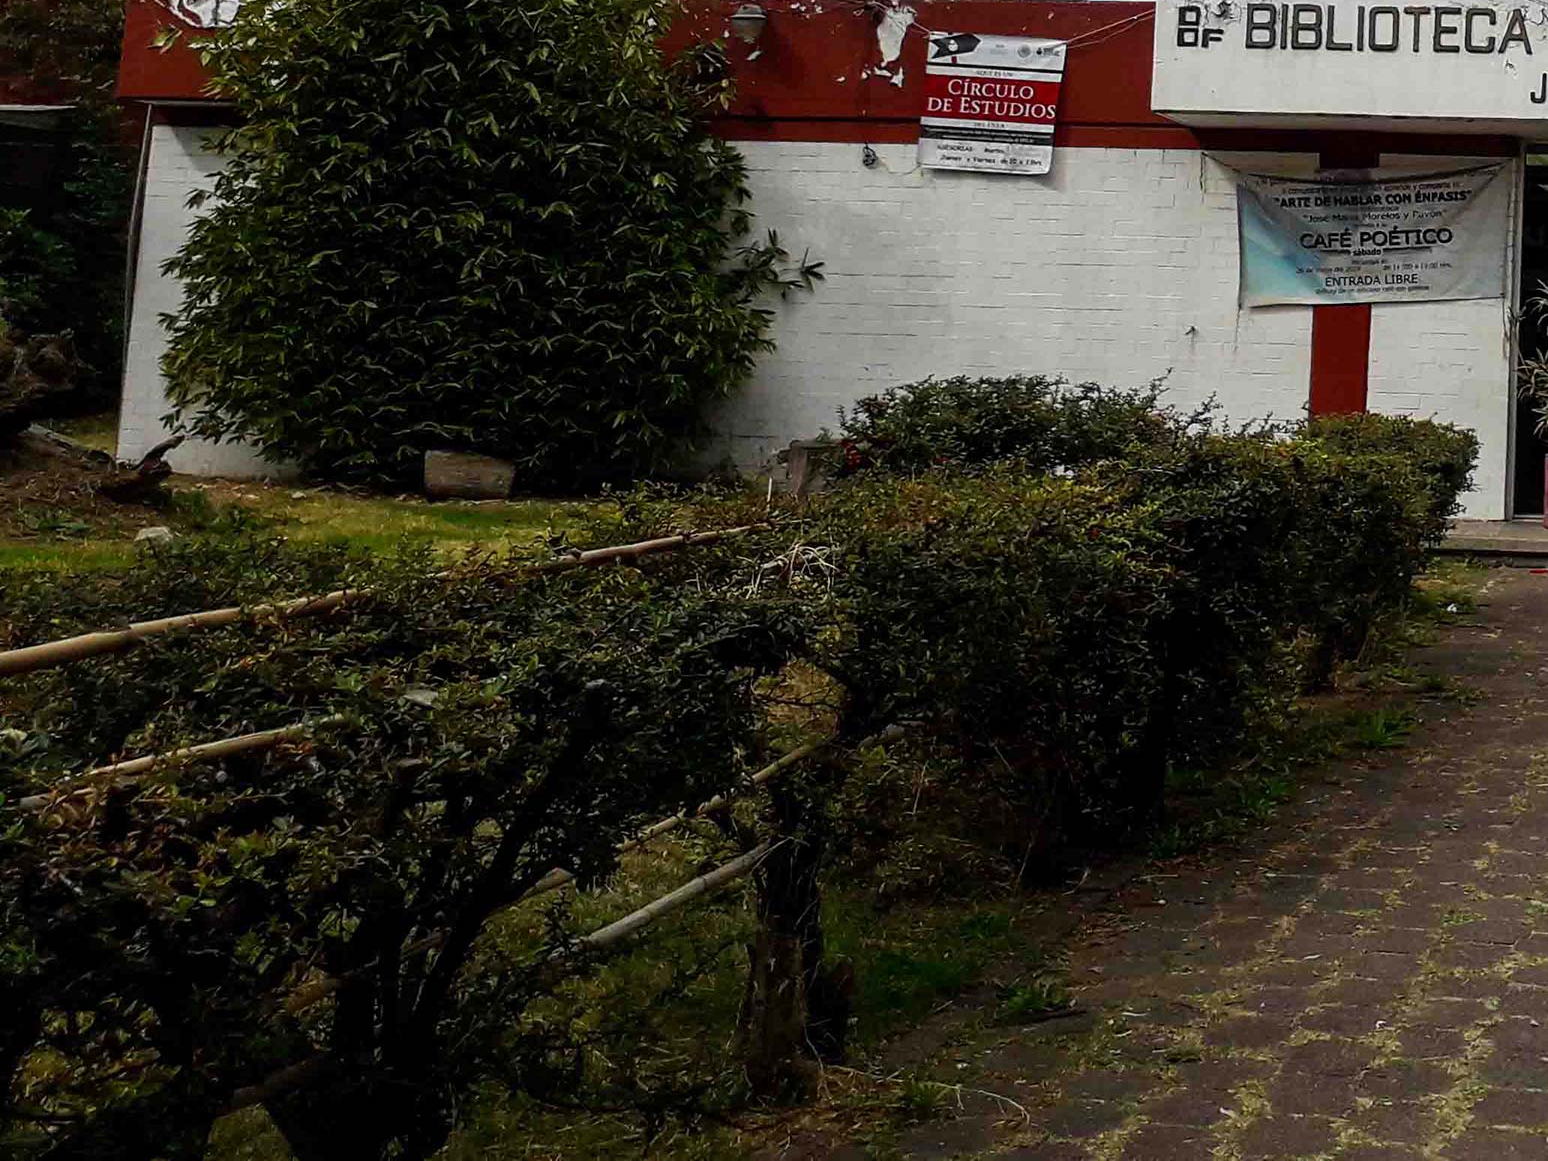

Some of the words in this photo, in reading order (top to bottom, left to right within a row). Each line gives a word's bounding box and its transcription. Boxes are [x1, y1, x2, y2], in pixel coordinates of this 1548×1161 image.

[1245, 1, 1533, 55] BIBLIOTECA
[947, 78, 1034, 100] CÍRCULO
[927, 97, 953, 113] DE
[959, 96, 1057, 120] ESTUDIOS
[1314, 194, 1331, 207] DE
[1334, 192, 1383, 207] HABLAR
[1385, 192, 1412, 205] CON
[1299, 227, 1352, 249] CAFÉ
[1358, 225, 1454, 247] POÉTICO
[1325, 274, 1381, 288] ENTRADA
[1384, 273, 1419, 286] LIBRE
